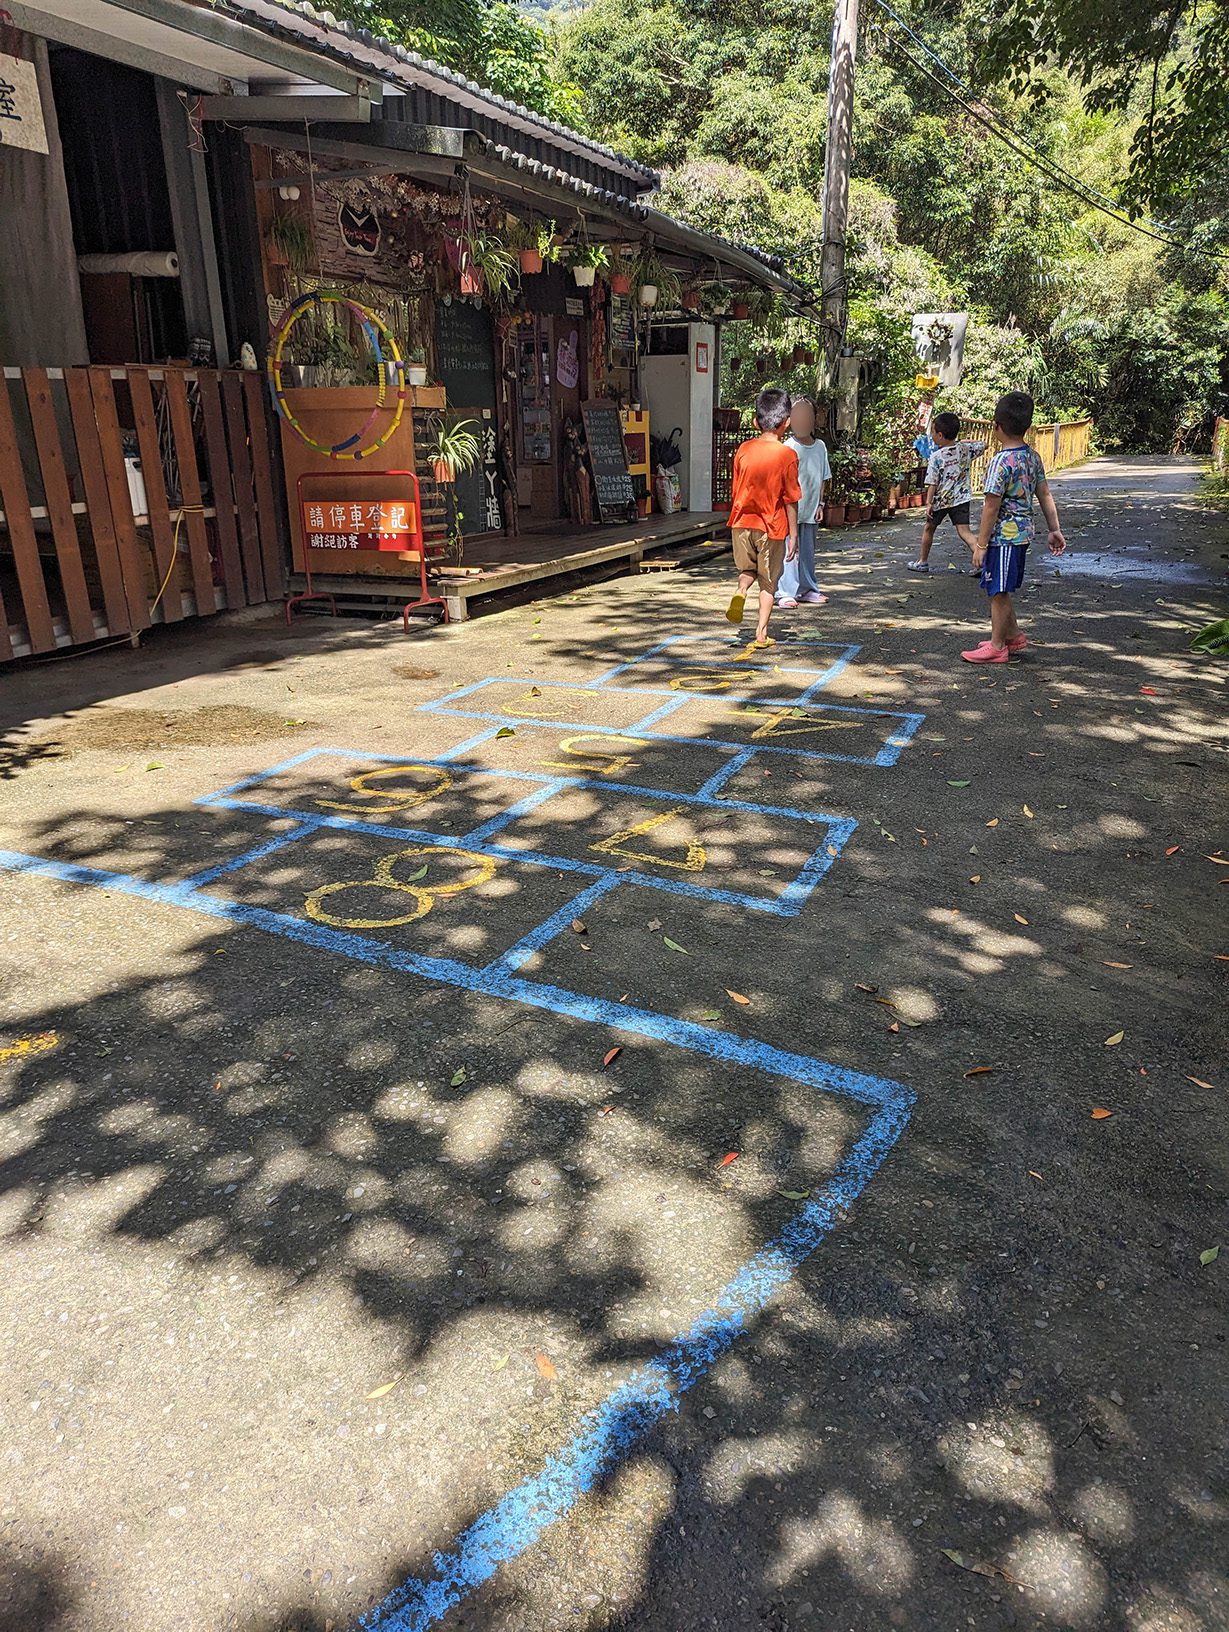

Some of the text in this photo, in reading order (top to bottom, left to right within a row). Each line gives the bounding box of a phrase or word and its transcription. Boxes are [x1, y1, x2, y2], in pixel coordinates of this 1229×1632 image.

[309, 504, 409, 531] 請停車登記
[304, 846, 496, 928] 8
